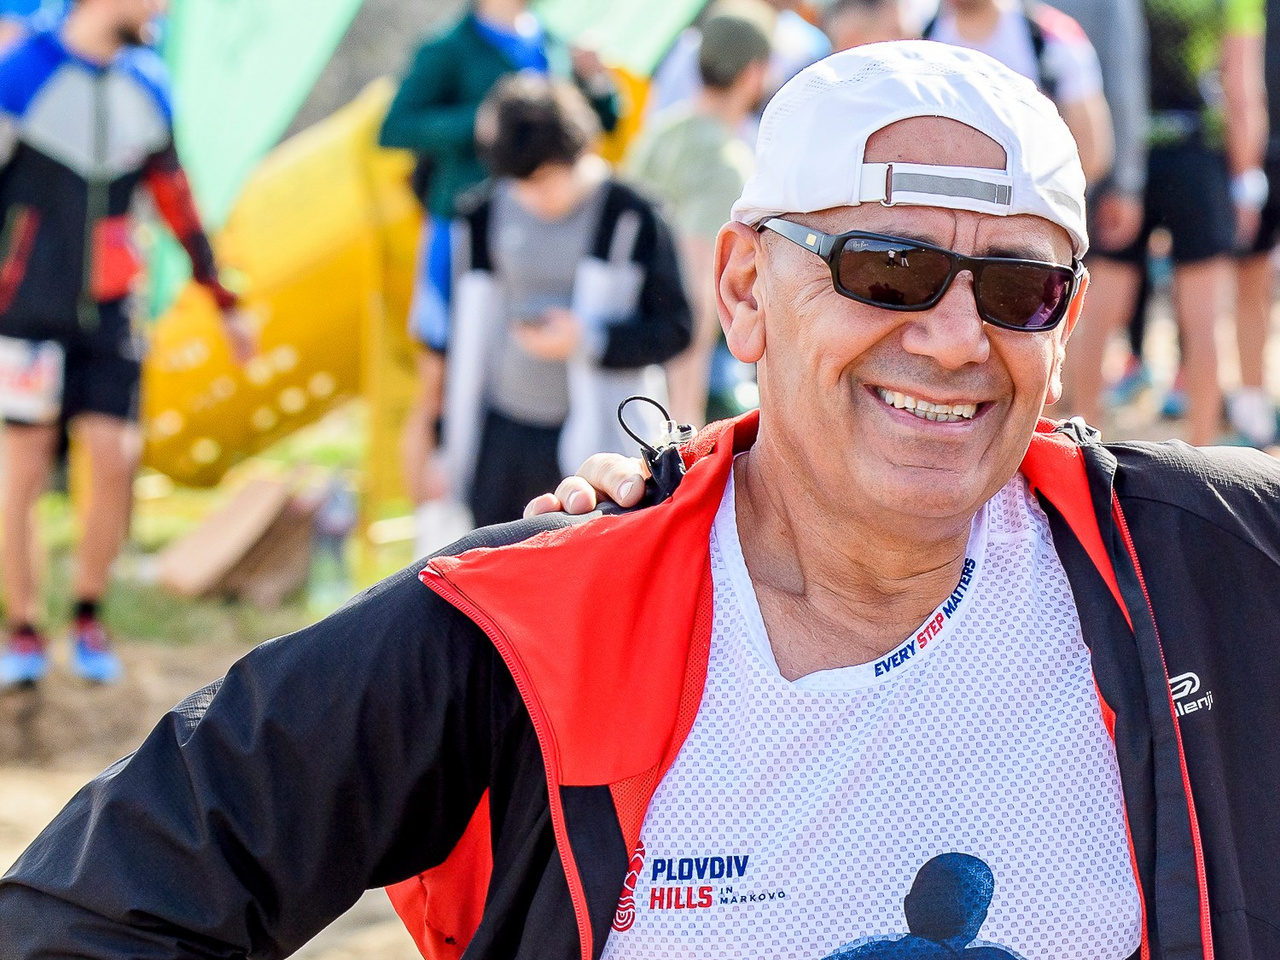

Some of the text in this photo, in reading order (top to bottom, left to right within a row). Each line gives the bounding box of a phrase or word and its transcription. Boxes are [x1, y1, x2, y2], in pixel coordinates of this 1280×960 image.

[874, 557, 976, 677] EVERY STEP MATTERS
[1174, 691, 1213, 717] lenji
[651, 855, 749, 881] PLOVDIV
[649, 886, 713, 909] HILLS
[719, 886, 733, 894] IN
[719, 891, 786, 904] MARKOVO
